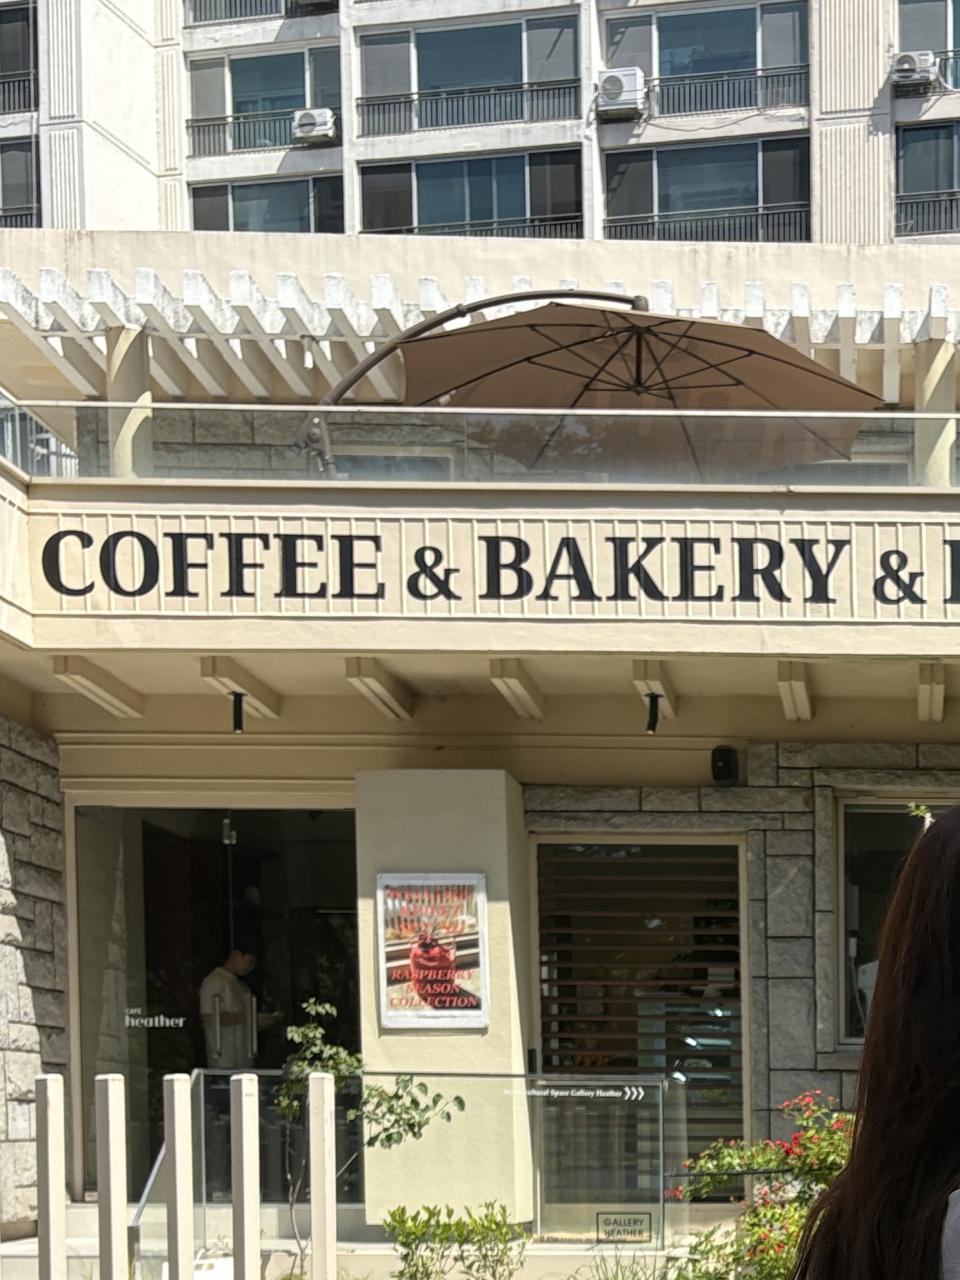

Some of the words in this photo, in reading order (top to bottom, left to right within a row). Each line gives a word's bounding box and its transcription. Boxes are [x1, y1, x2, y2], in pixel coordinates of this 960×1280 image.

[42, 529, 386, 599] COFFEE
[406, 545, 463, 601] &
[478, 535, 850, 603] BAKERY
[873, 549, 926, 604] &
[391, 969, 475, 980] RASPBERRY
[405, 983, 461, 994] SEASON
[389, 997, 479, 1008] COLLECTION
[125, 1014, 186, 1028] heather
[571, 1088, 595, 1099] Gallery
[596, 1089, 623, 1098] Heather
[603, 1218, 645, 1228] GALLERY
[604, 1228, 644, 1238] HEATHER
